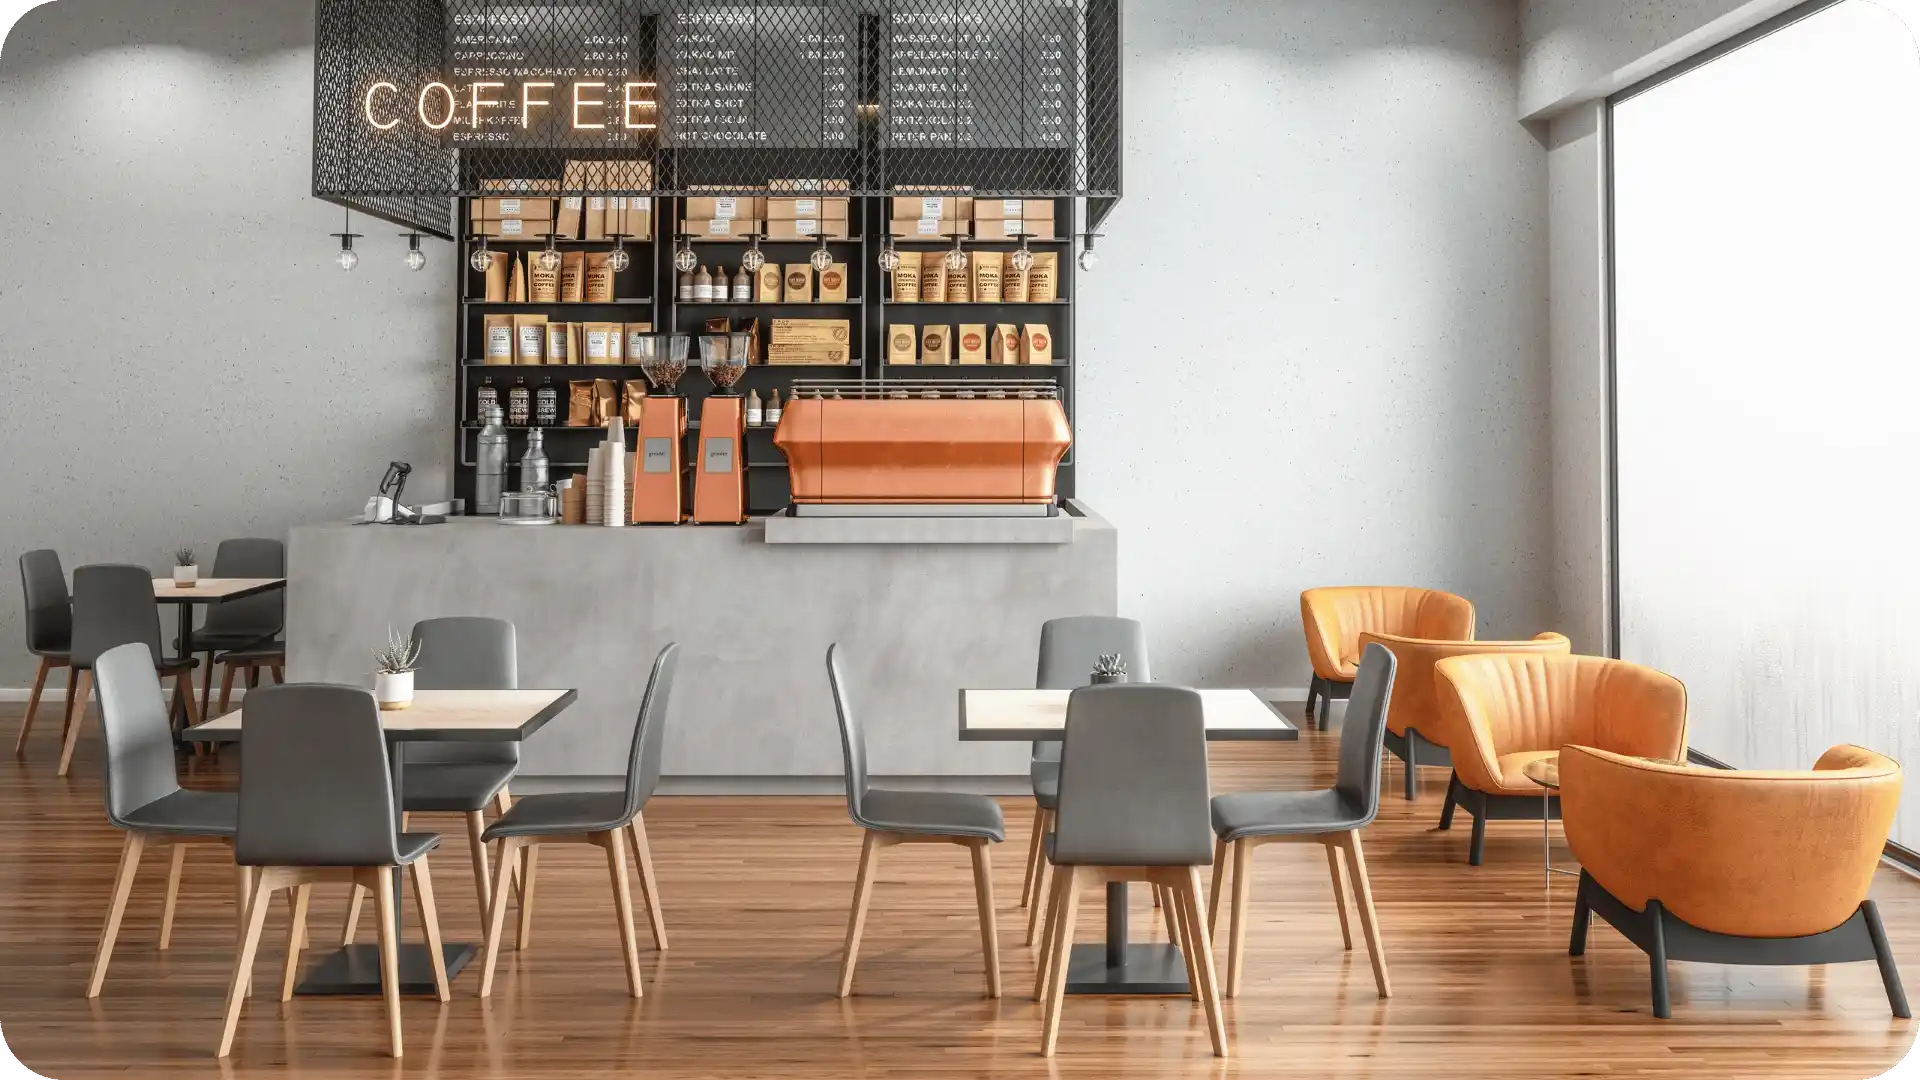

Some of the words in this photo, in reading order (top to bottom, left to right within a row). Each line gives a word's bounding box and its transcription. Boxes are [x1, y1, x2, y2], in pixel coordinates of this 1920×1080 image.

[454, 14, 529, 25] ESPRESSO
[677, 13, 754, 24] ESPRESSO
[892, 13, 983, 24] SOFTDRINKS
[454, 35, 518, 44] AMERICANO
[799, 34, 821, 43] 200
[892, 34, 938, 43] WASSER
[454, 51, 525, 60] CAPPUCCINO
[454, 67, 511, 76] ESPRESSO
[514, 67, 577, 76] MACCHIATO
[705, 66, 739, 76] LATTE
[453, 83, 485, 93] LATE
[365, 81, 657, 129] COFFEE
[454, 100, 477, 109] FLA
[453, 132, 510, 141] ESPRESSO
[701, 131, 767, 140] CHOCOLATE
